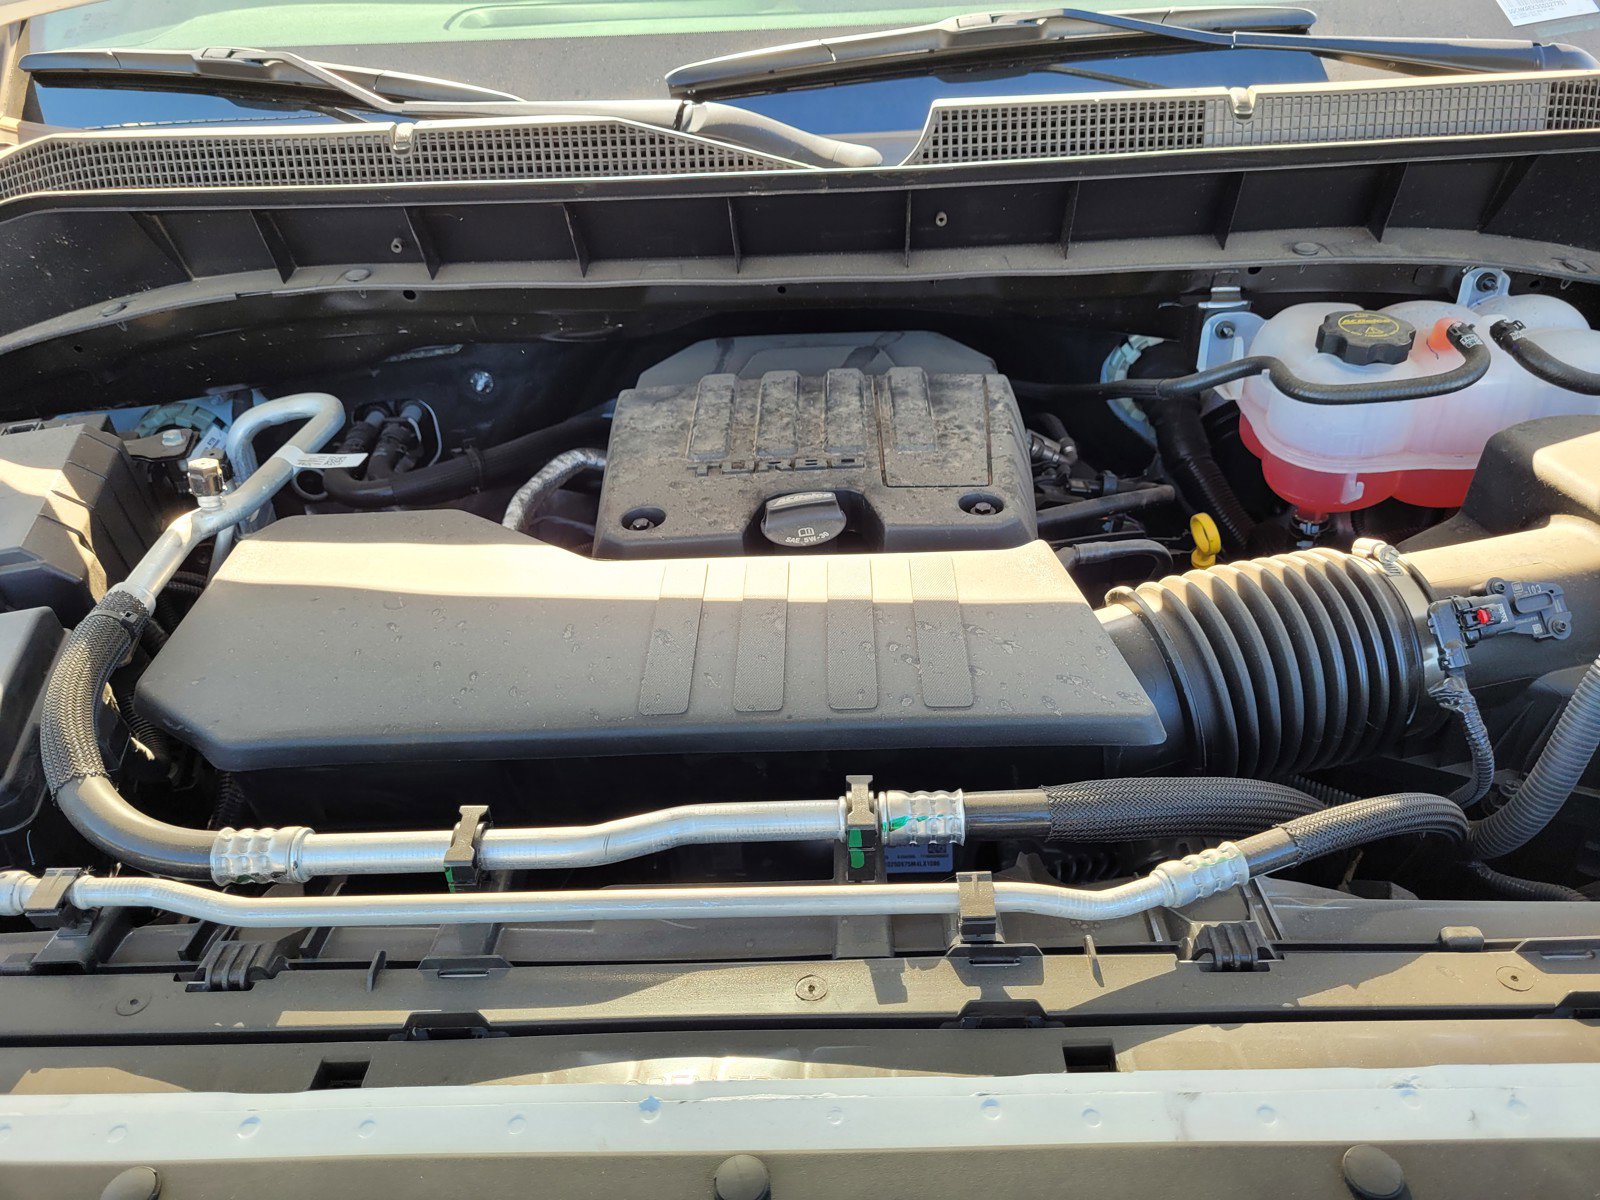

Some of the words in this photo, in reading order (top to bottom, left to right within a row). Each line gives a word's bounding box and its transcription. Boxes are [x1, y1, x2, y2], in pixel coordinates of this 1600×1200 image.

[687, 458, 865, 477] TURBO
[785, 536, 800, 544] SAE
[803, 531, 830, 543] 5W-30
